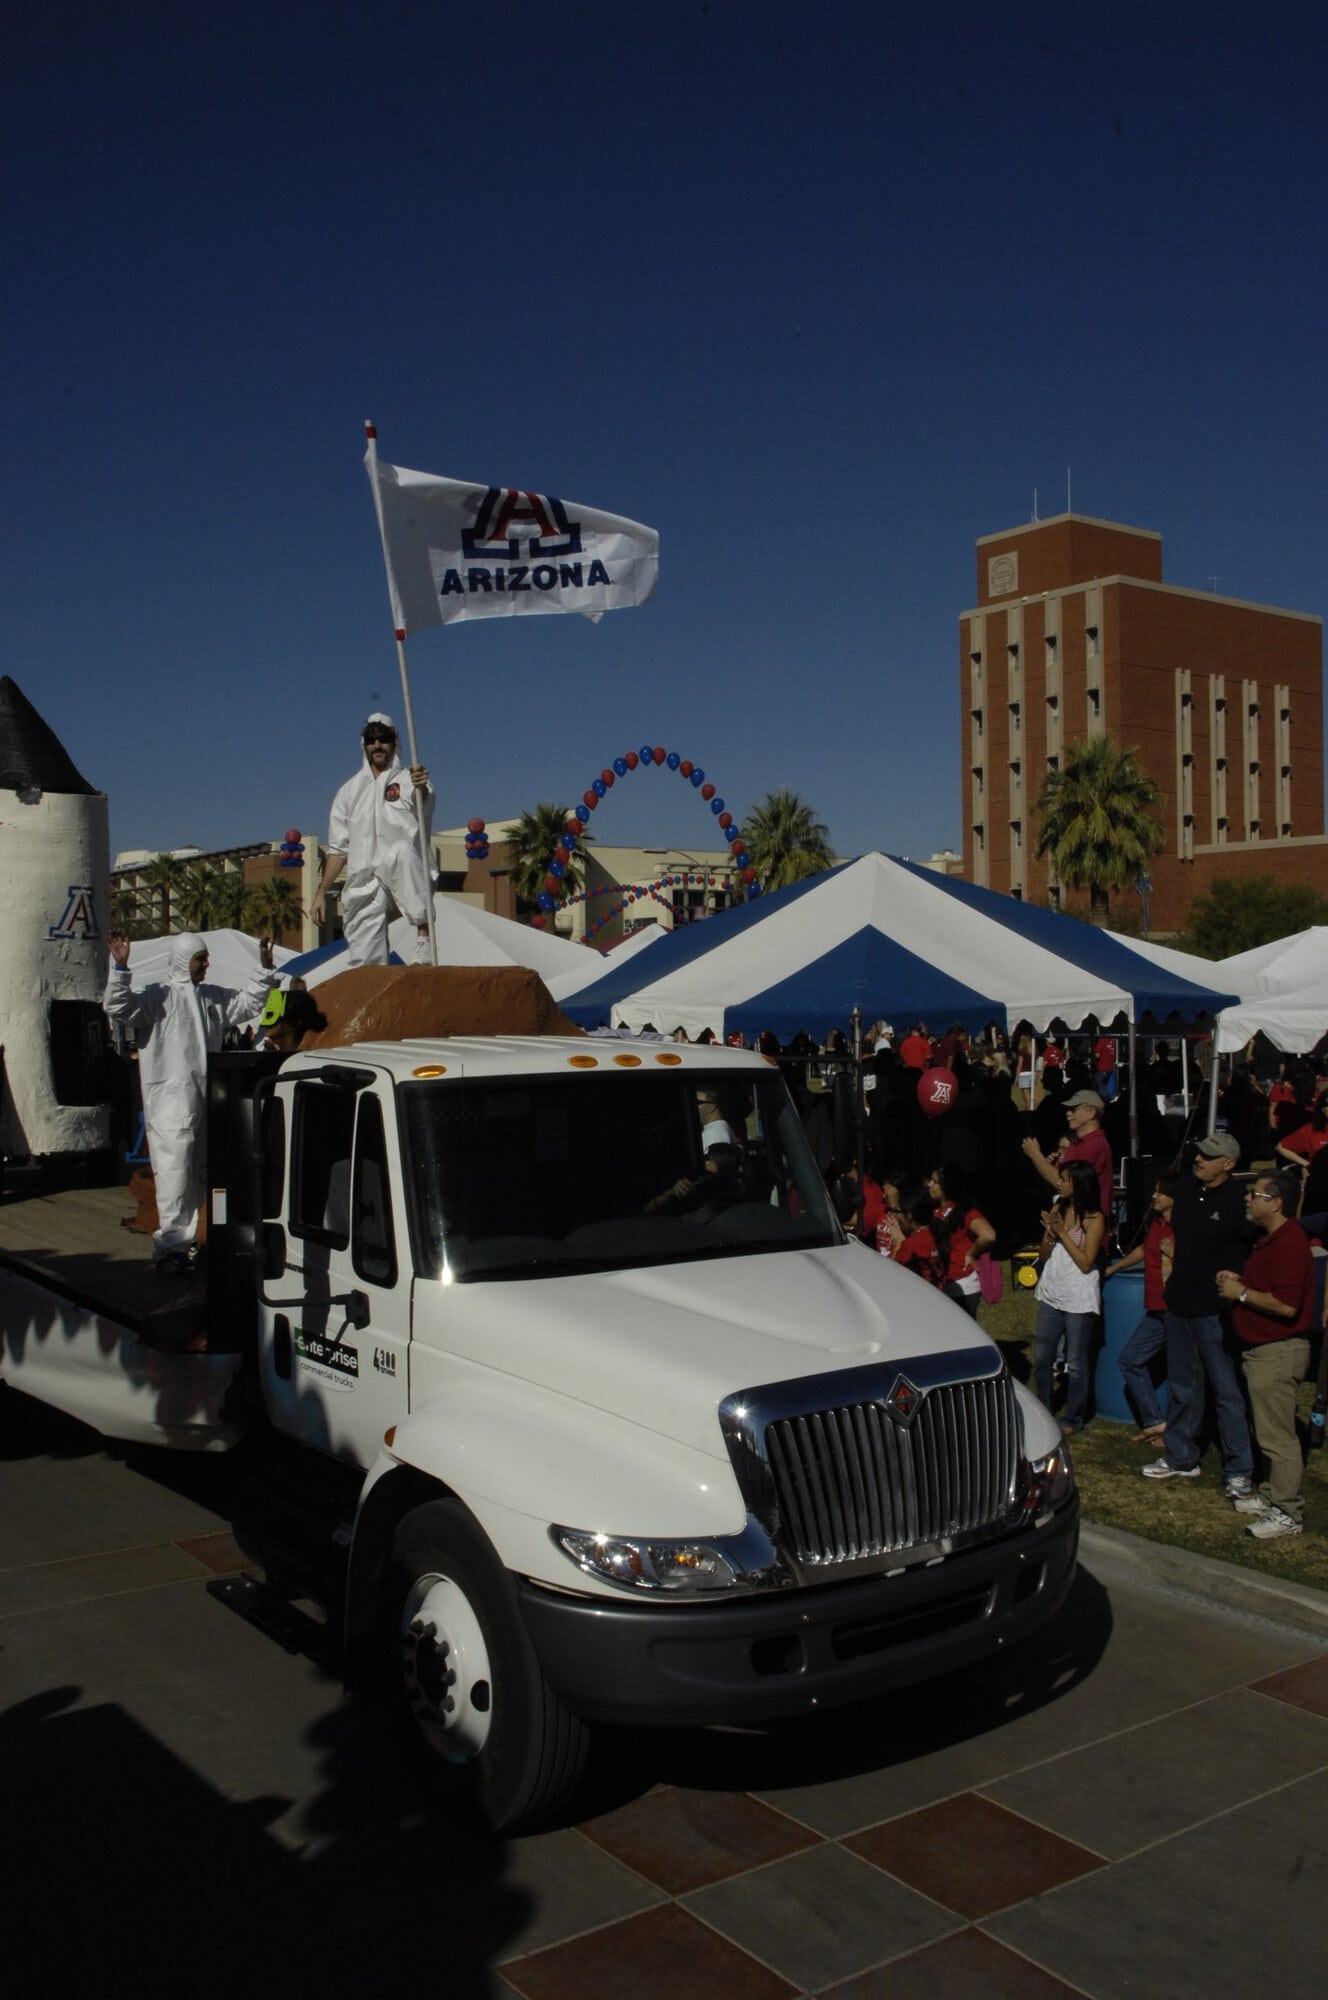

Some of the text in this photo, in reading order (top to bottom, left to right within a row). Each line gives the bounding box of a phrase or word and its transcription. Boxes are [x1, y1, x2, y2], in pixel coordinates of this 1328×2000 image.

[441, 560, 611, 595] ARIZONA
[49, 886, 98, 938] A
[930, 1082, 952, 1104] A
[300, 1362, 354, 1389] commercial trucks
